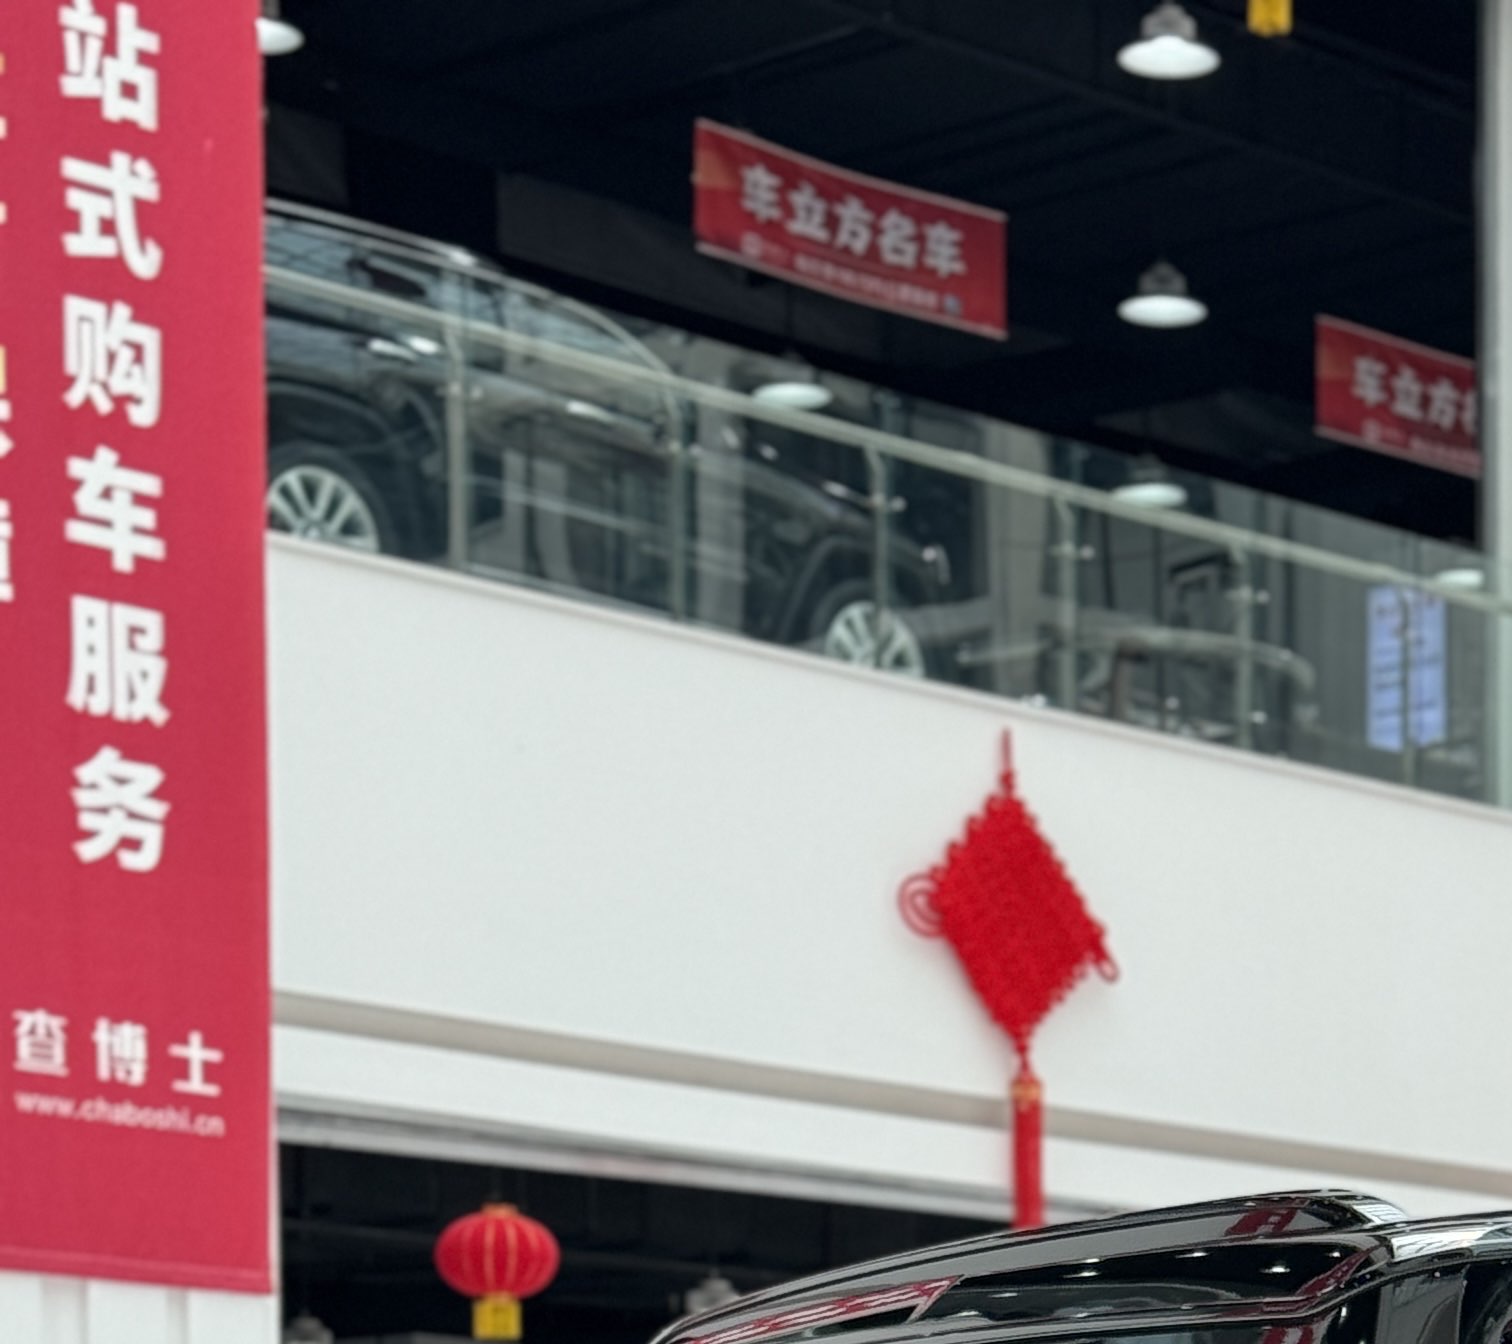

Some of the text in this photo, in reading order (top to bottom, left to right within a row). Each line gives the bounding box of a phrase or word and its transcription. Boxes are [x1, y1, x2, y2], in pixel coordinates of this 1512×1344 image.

[739, 163, 968, 278] 车立方名车
[58, 0, 171, 872] 站式购车服务
[11, 1008, 225, 1098] 查博士
[14, 1091, 227, 1138] www.chaboshi.cn
